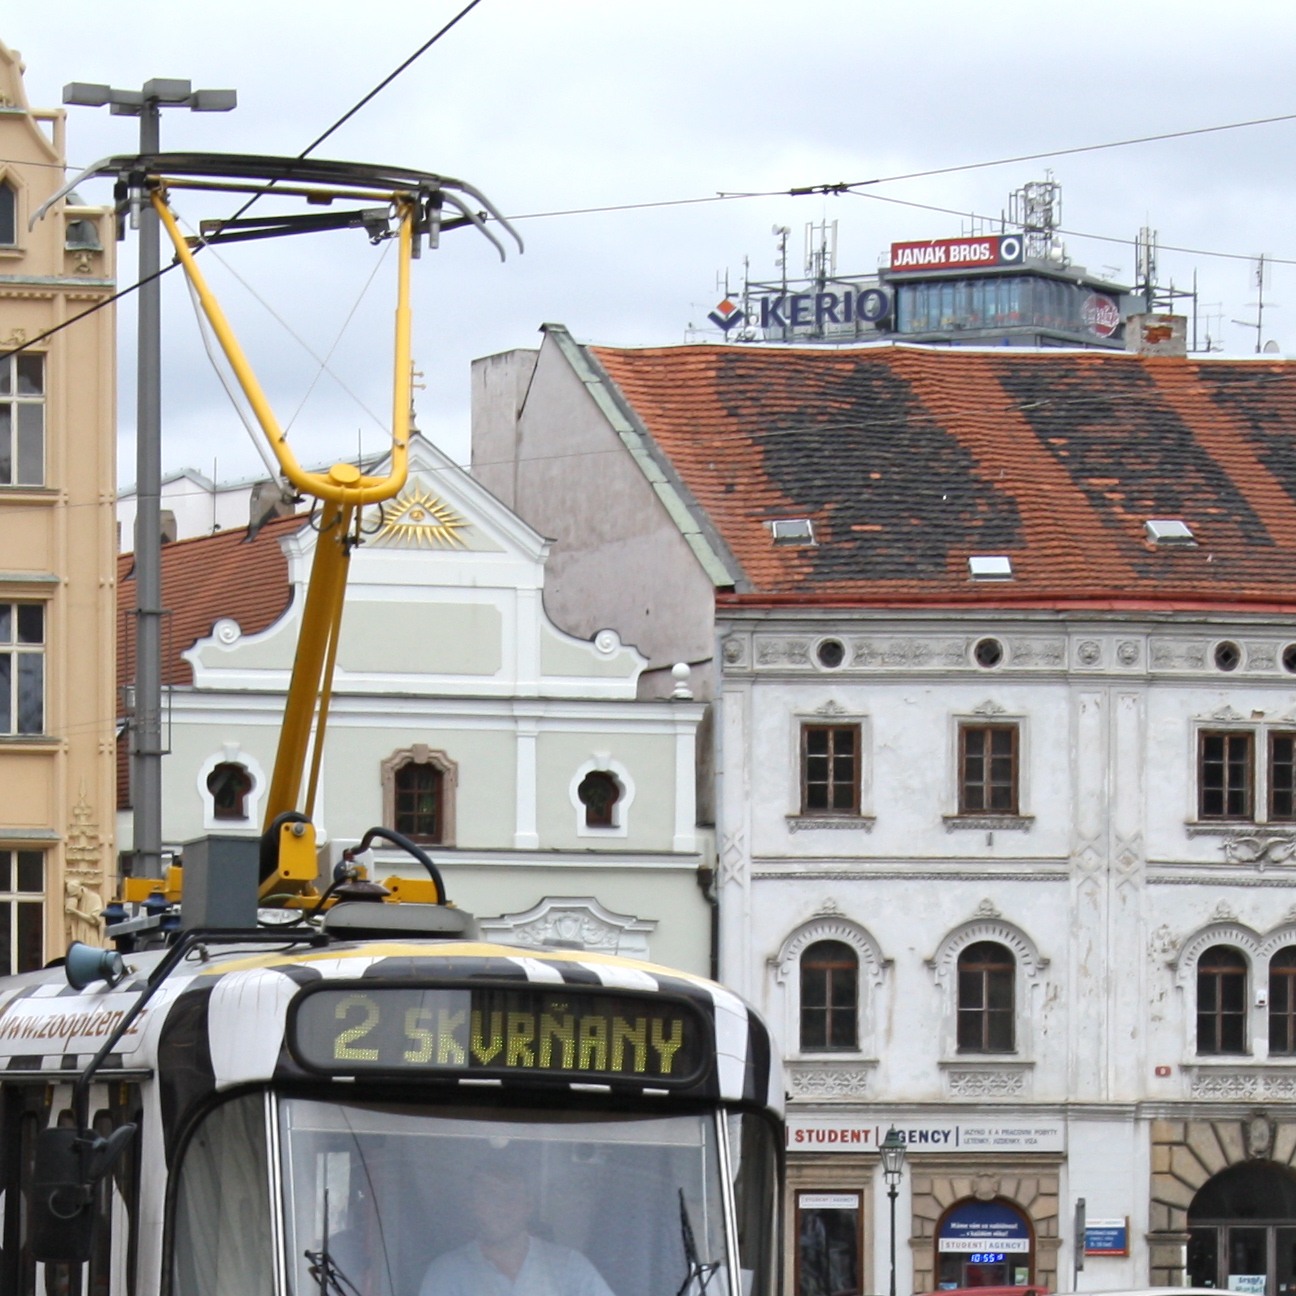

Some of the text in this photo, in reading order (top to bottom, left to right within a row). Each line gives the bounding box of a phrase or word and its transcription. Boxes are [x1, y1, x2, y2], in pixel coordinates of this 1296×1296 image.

[894, 239, 994, 267] JANÁK BROS.
[760, 288, 889, 328] KERIO
[333, 993, 683, 1074] 2 SKVRŇANY
[794, 1129, 952, 1143] STUDENT GENCY
[945, 1241, 1022, 1250] STUDENT AGENCY
